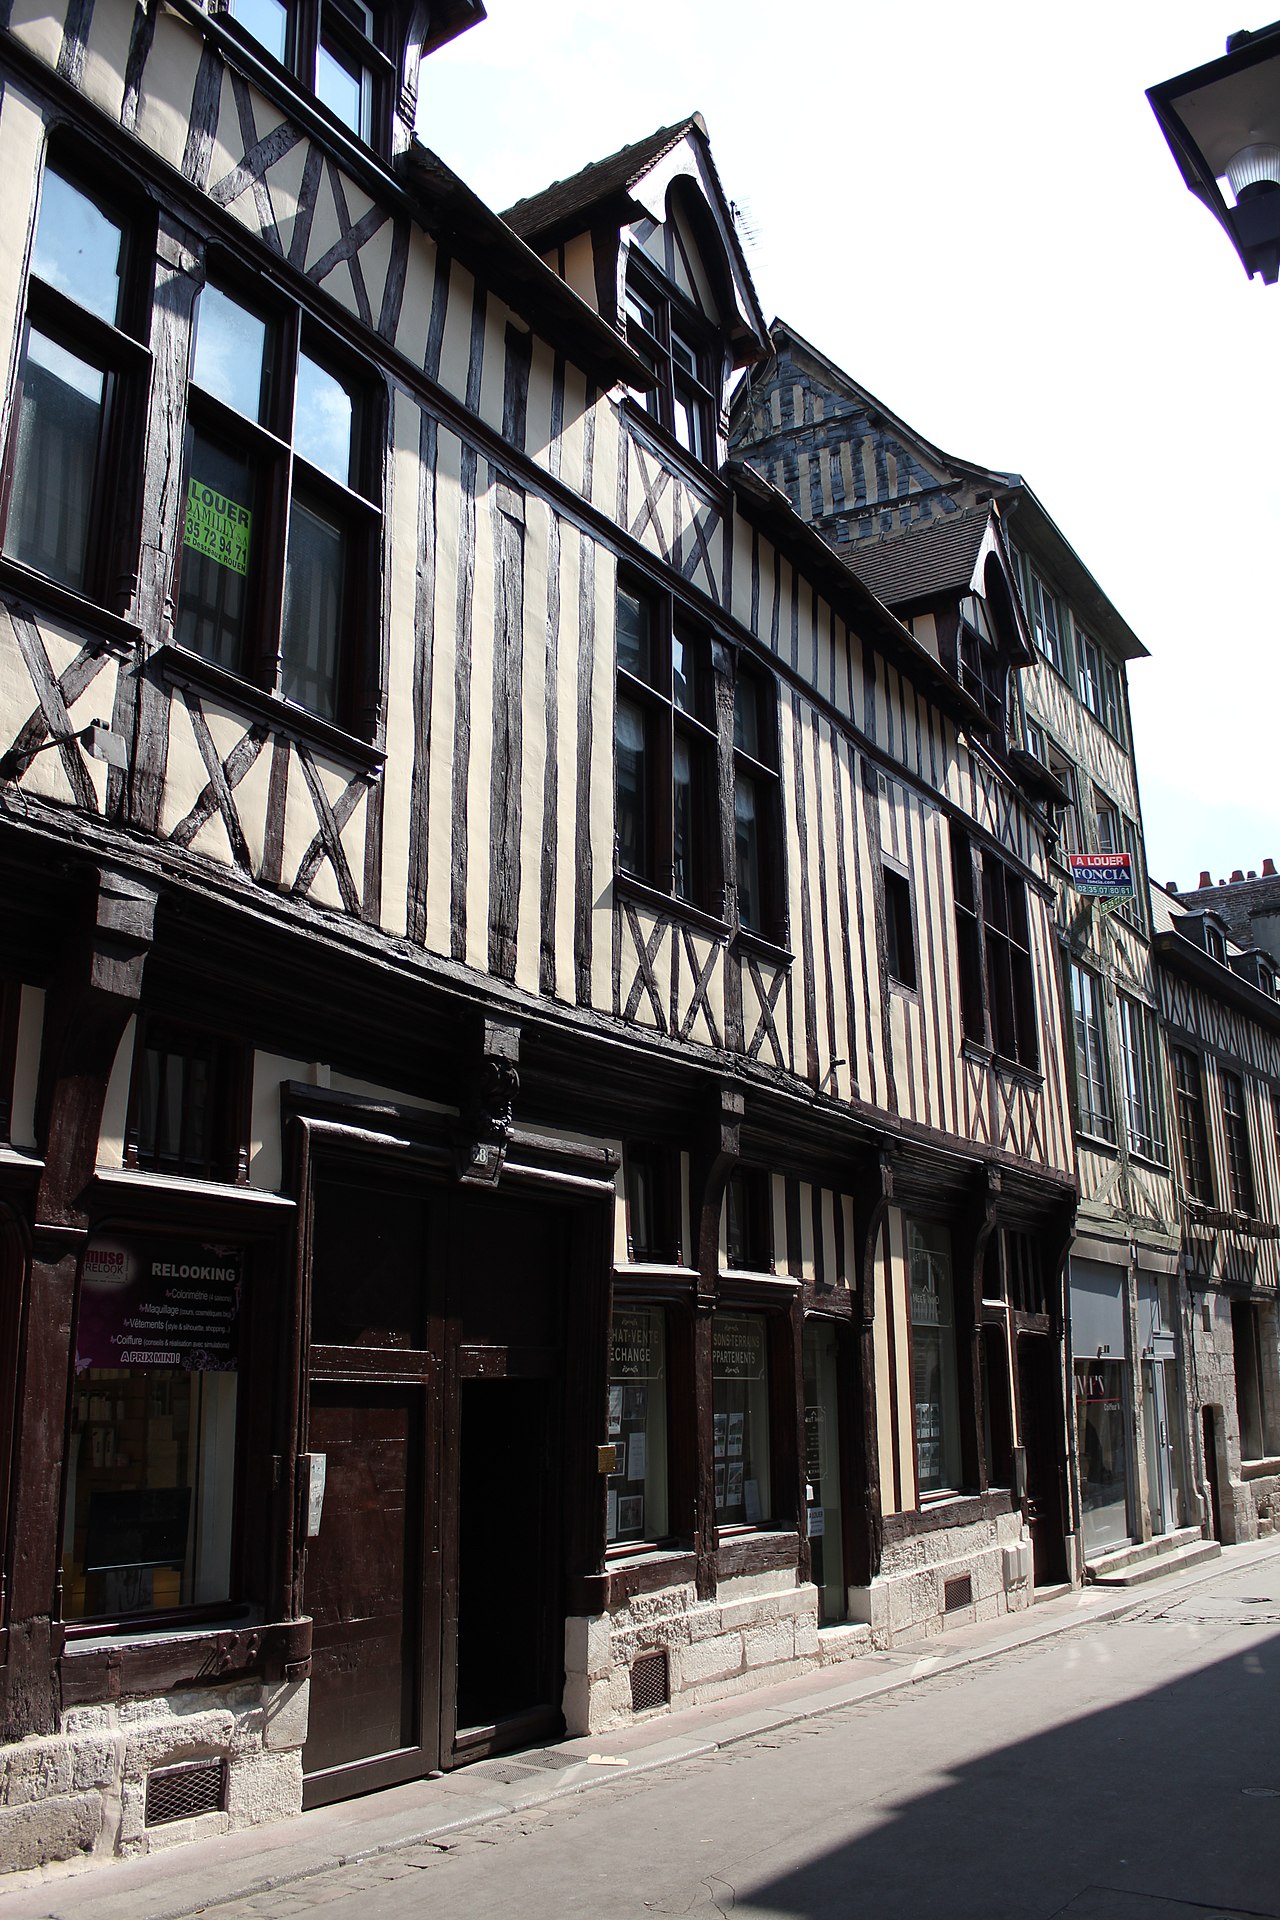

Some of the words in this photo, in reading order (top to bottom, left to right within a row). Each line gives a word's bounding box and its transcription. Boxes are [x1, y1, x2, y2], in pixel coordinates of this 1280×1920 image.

[192, 482, 249, 528] LOUER
[187, 518, 200, 539] 35
[203, 527, 217, 548] 72
[219, 536, 232, 557] 94
[236, 544, 247, 565] 71
[223, 555, 246, 573] ROUEN
[1076, 856, 1085, 866] A
[1087, 856, 1124, 866] LOUER
[1074, 868, 1130, 880] FONCIA
[1077, 885, 1087, 893] 02
[1088, 886, 1098, 894] 35
[1099, 887, 1108, 895] 07
[86, 1250, 125, 1265] muse
[85, 1263, 125, 1274] RELOOK
[151, 1262, 236, 1282] RELOOKING
[144, 1303, 180, 1317] Maquillage
[129, 1318, 165, 1331] Vêtements
[116, 1334, 143, 1346] Coiffure
[120, 1351, 129, 1363] A
[130, 1351, 153, 1364] PRIX
[153, 1352, 176, 1364] MINI
